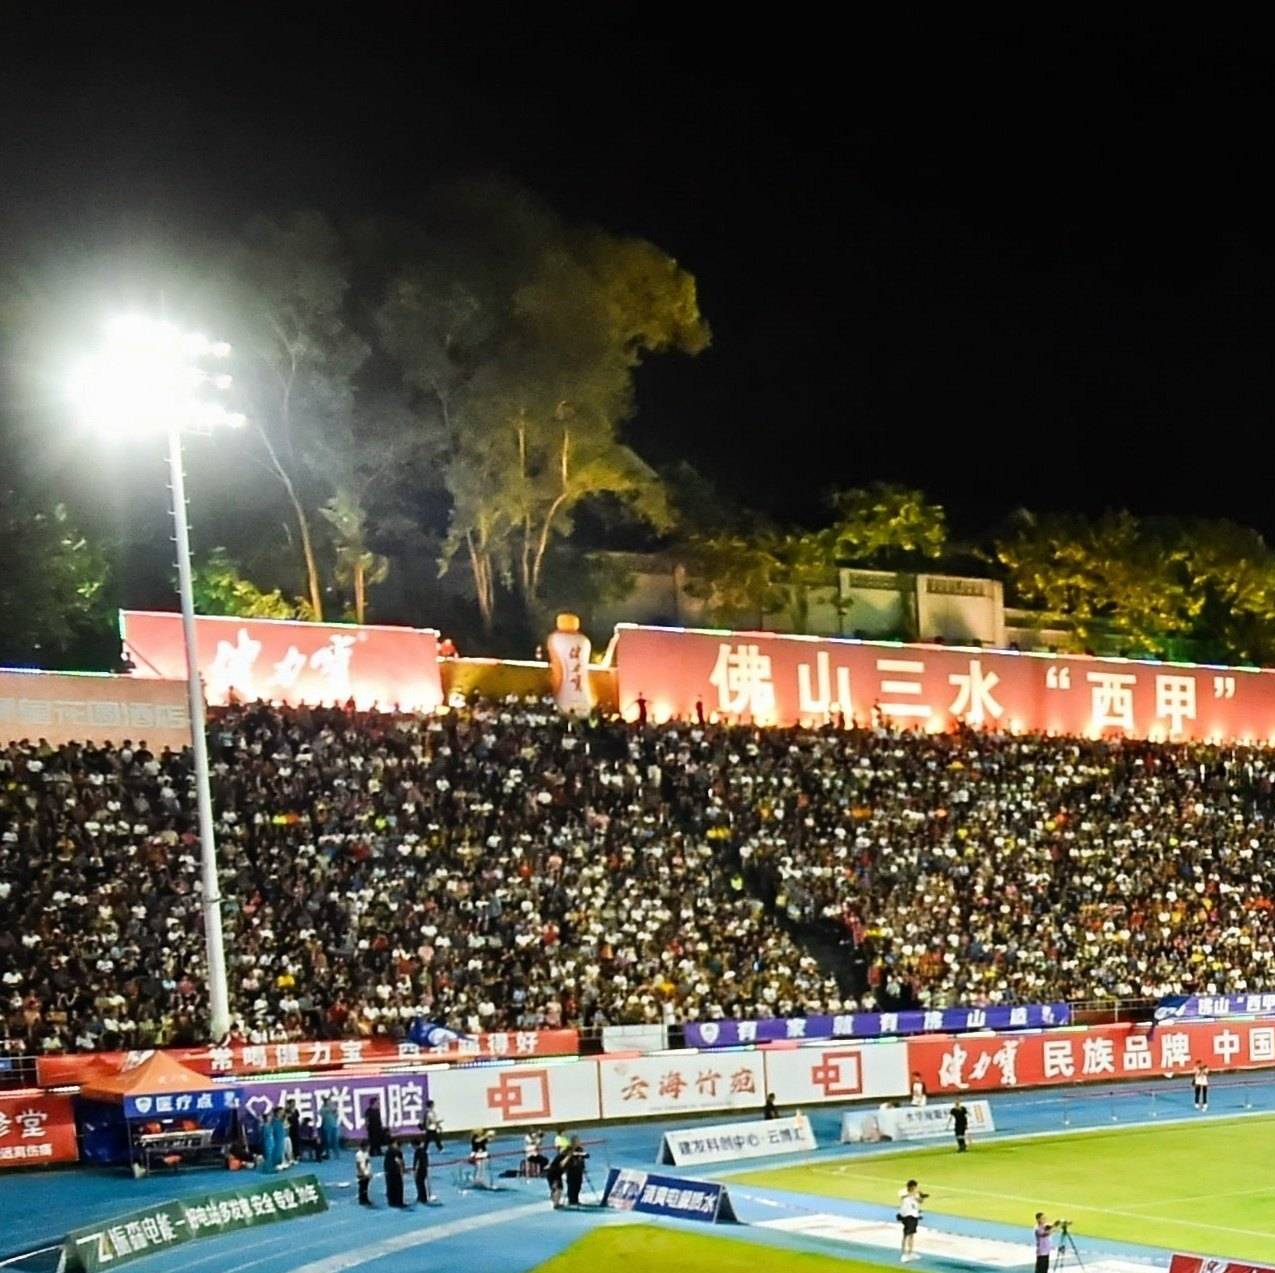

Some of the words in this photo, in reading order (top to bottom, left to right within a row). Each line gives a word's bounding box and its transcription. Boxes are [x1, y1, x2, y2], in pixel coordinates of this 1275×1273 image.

[711, 642, 1236, 731] 佛山三水“西甲”
[210, 1040, 365, 1070] 常喝健力宝
[1042, 1032, 1192, 1079] 民族品牌
[621, 1067, 757, 1101] 云海竹苑
[156, 1092, 213, 1112] 医疗点
